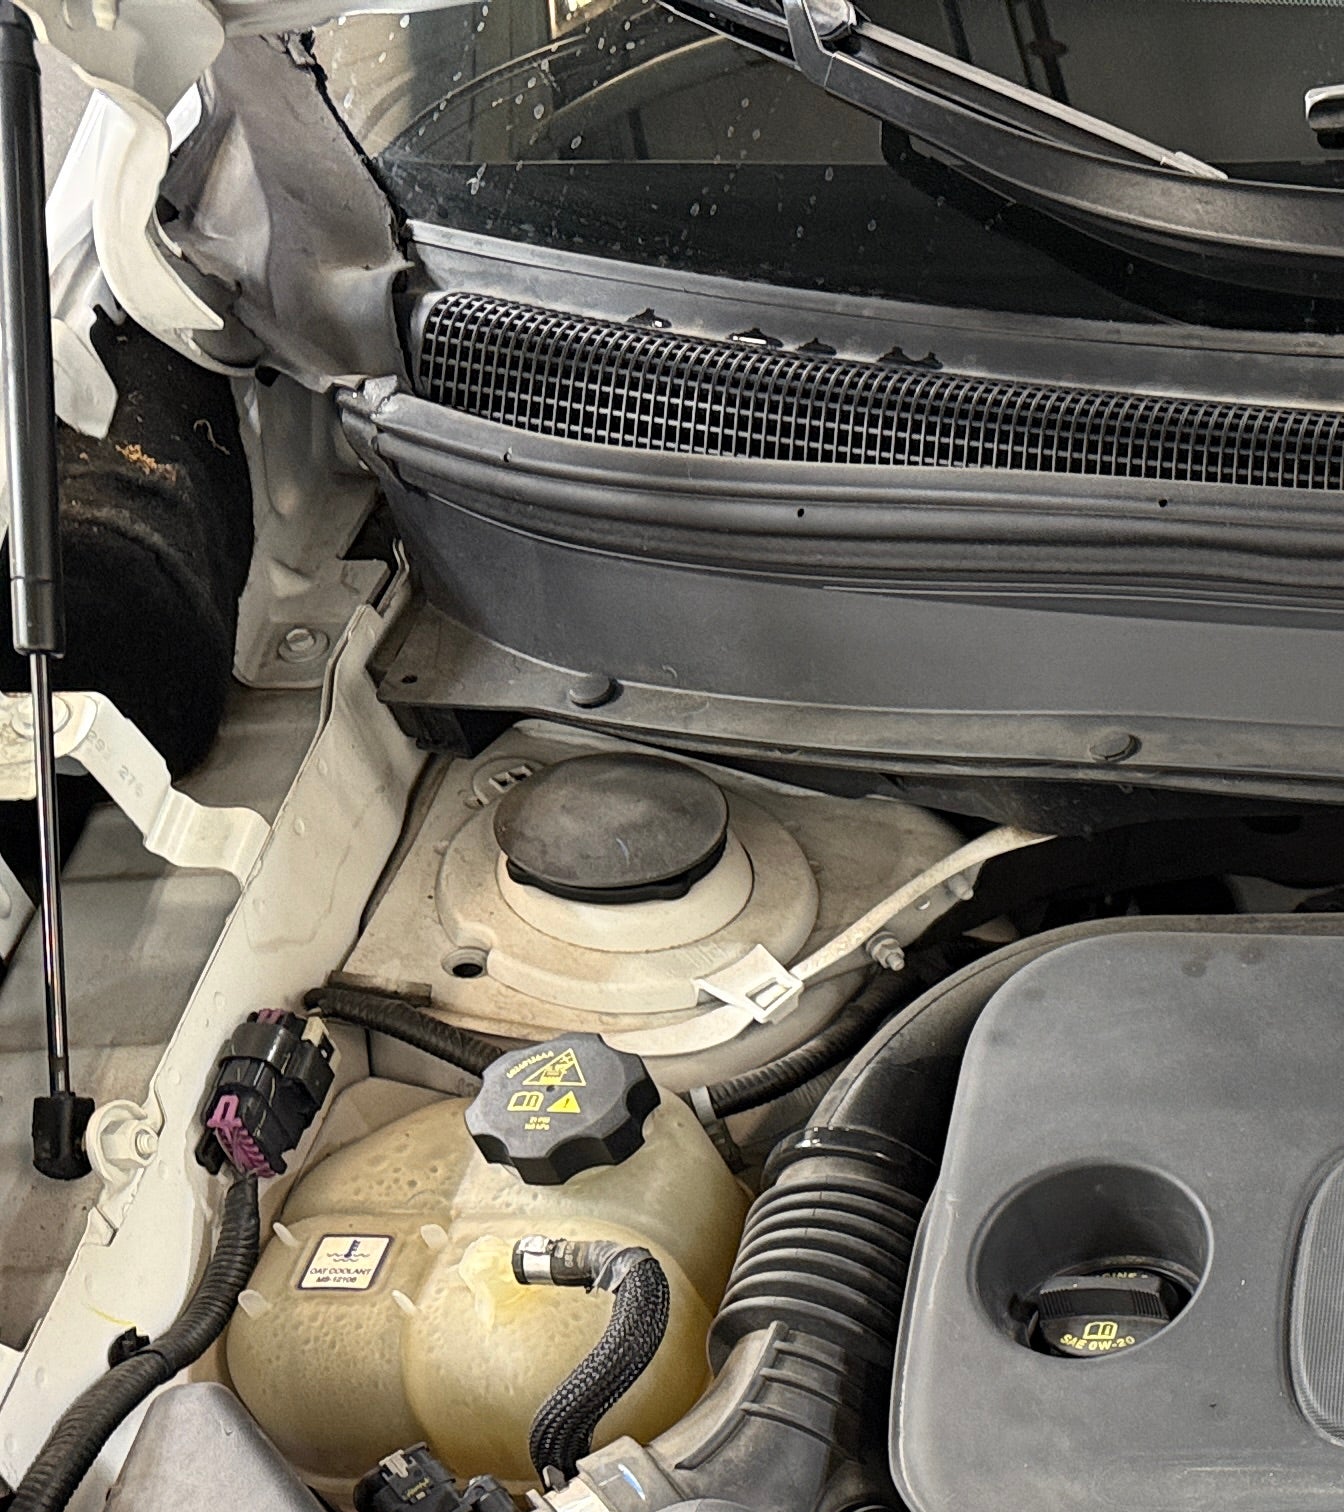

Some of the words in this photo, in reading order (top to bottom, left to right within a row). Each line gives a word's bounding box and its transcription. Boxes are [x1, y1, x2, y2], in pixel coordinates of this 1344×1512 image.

[328, 1267, 372, 1275] COOLANT
[1060, 1333, 1088, 1350] SAE
[1088, 1335, 1136, 1351] 0W-20
